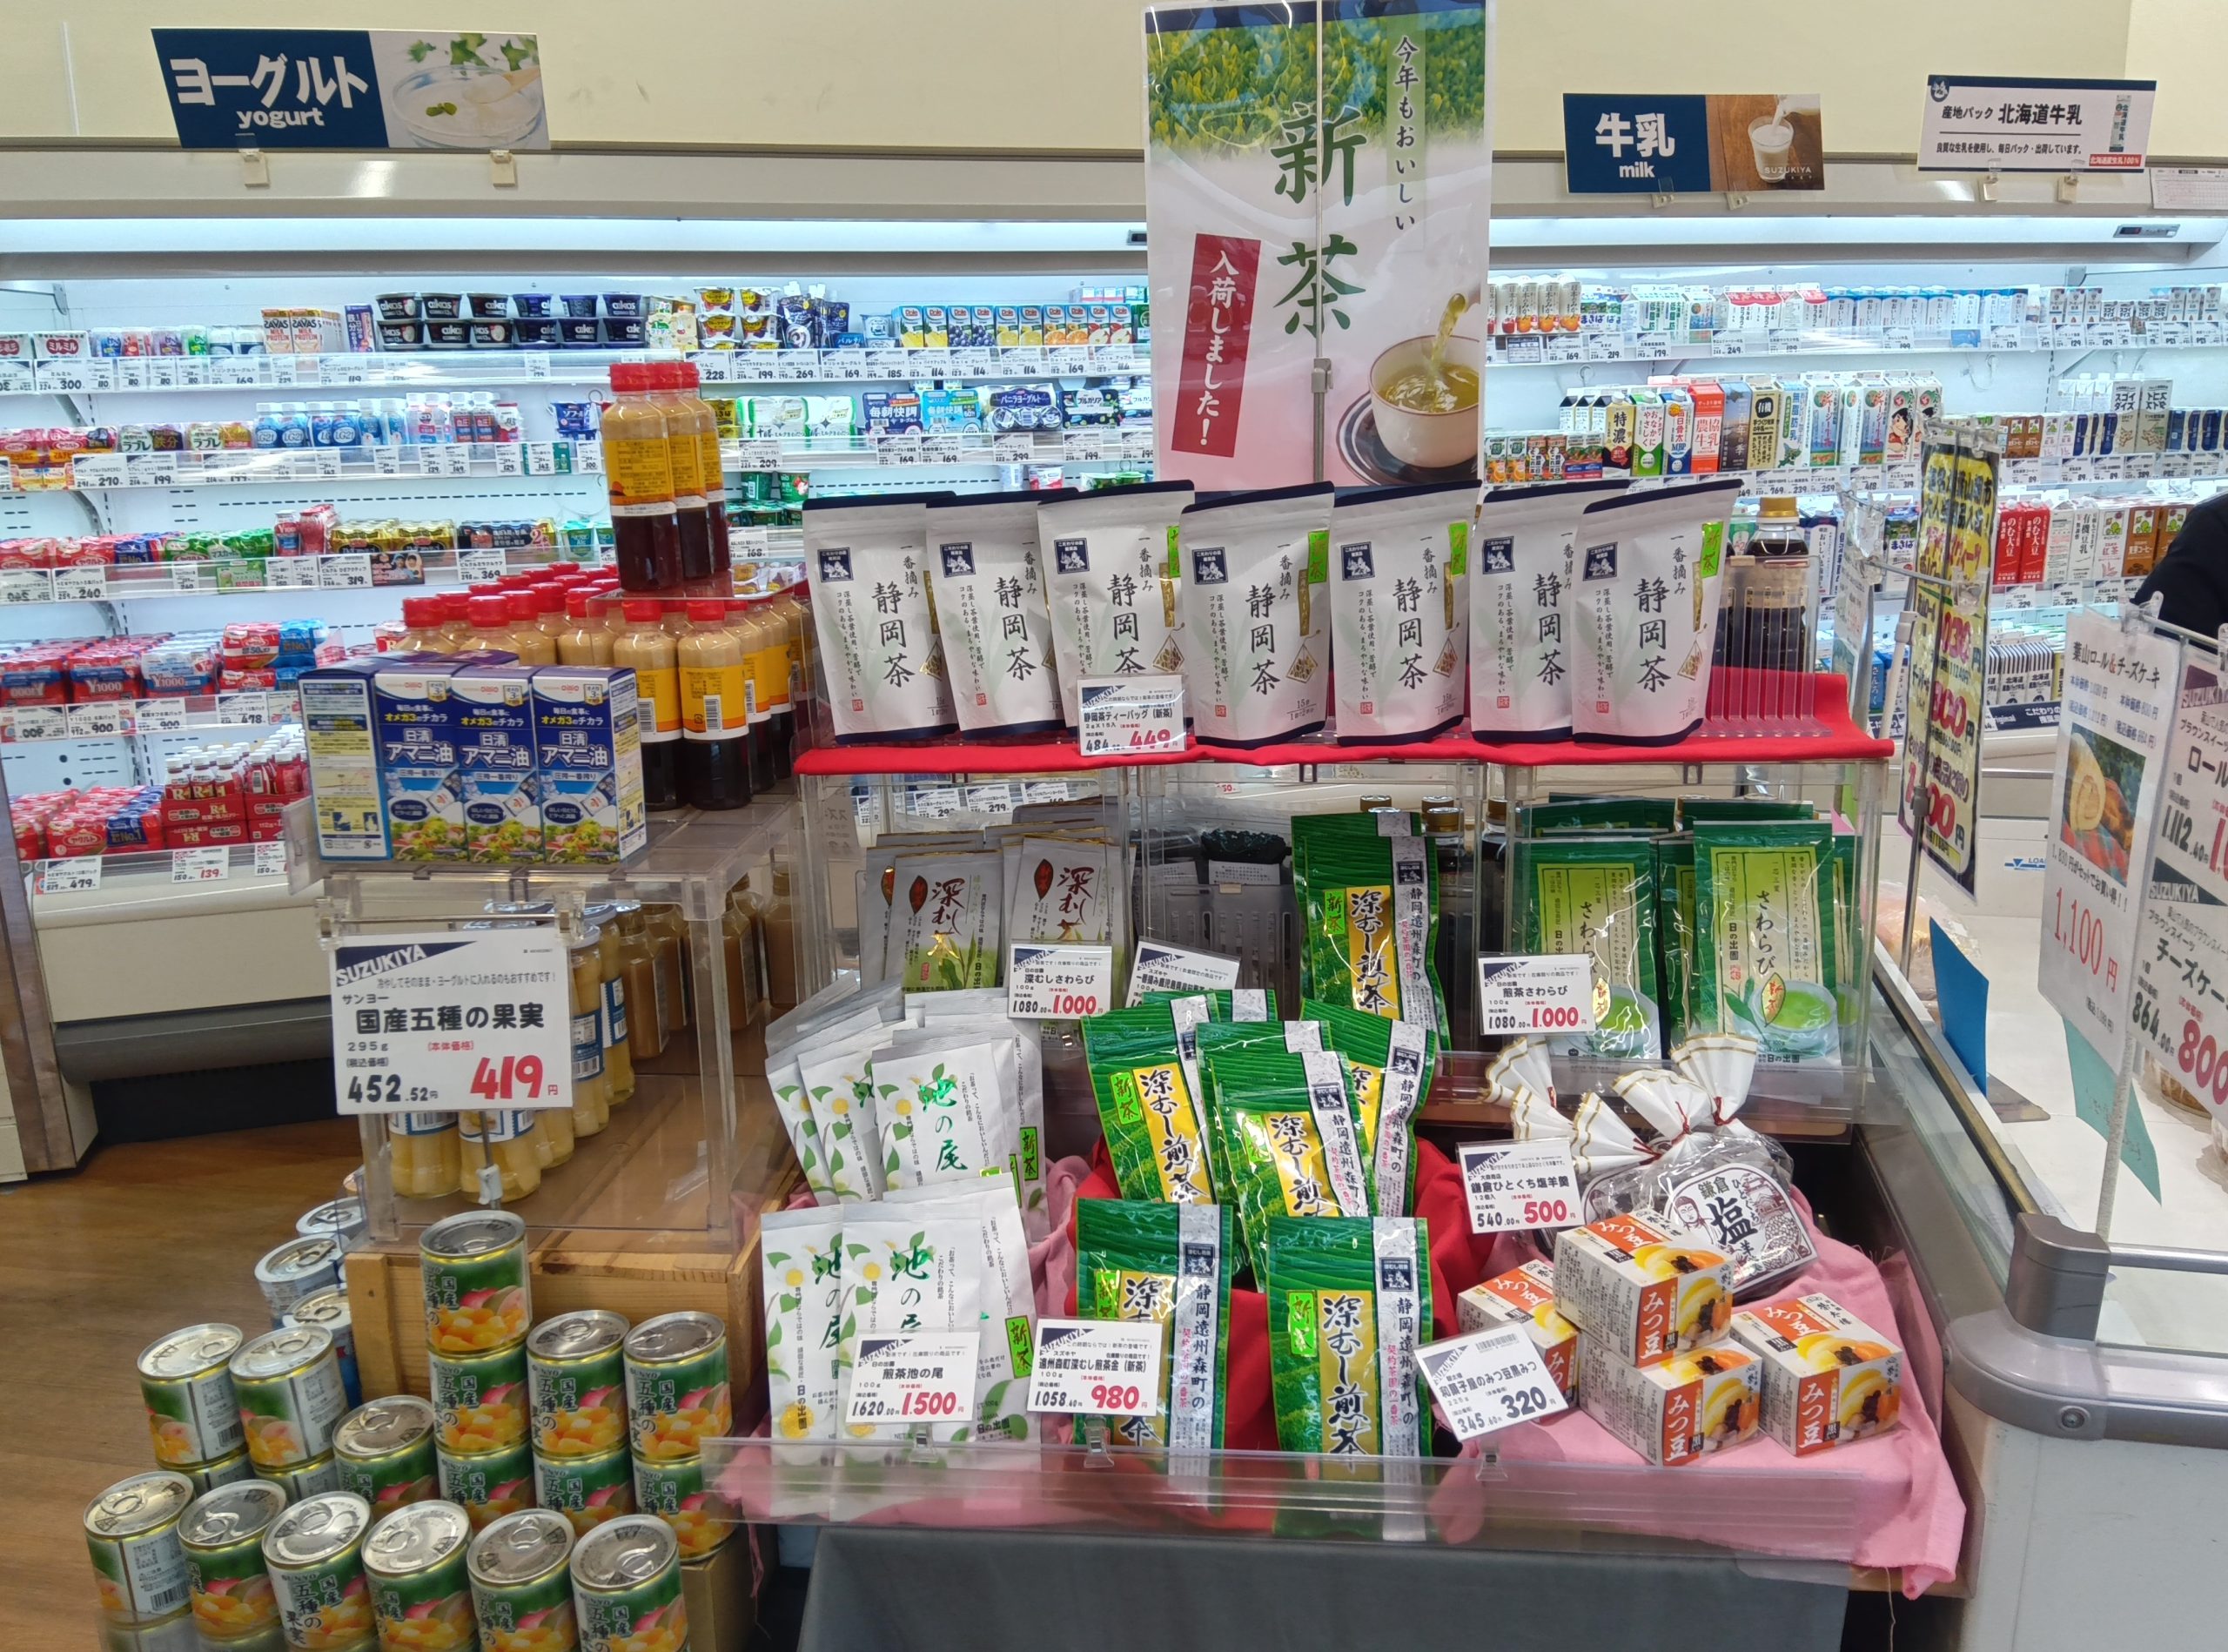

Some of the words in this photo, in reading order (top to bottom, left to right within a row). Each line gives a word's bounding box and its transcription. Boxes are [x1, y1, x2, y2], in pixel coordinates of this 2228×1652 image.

[170, 52, 369, 110] ヨーグルト
[236, 107, 325, 130] yogurt
[1998, 103, 2083, 125] 北海道牛乳
[1393, 35, 1421, 232] 今年もおいしい
[1594, 111, 1675, 159] 牛乳
[1619, 162, 1655, 179] milk
[1764, 165, 1812, 174] SUZUKIYA
[1270, 100, 1367, 336] 新茶
[60, 379, 82, 390] 300
[706, 371, 724, 380] 228
[758, 371, 774, 379] 199
[796, 370, 814, 379] 269
[844, 369, 860, 379] 169
[888, 369, 903, 378] 185
[869, 406, 918, 418] 毎朝快調
[1001, 394, 1043, 405] バニラヨーグルト
[1613, 411, 1628, 445] 特濃
[79, 588, 101, 599] 240
[871, 580, 916, 688] 静岡茶
[993, 574, 1038, 682] 静岡茶
[1106, 572, 1147, 675] 静岡茶
[1245, 582, 1281, 696] 静岡茶
[1392, 575, 1429, 690] 静岡茶
[1532, 571, 1567, 687] 静岡茶
[1633, 575, 1672, 694] 静岡茶
[88, 679, 122, 694] Y1000
[151, 675, 185, 688] Y1000
[91, 722, 113, 734] 900
[403, 728, 432, 744] 日清
[480, 731, 509, 748] 日清
[560, 730, 587, 747] 日清
[385, 742, 455, 764] アマニ油
[461, 746, 531, 768] アマニ油
[541, 744, 608, 768] アマニ油
[70, 877, 92, 890] 479
[200, 869, 219, 878] 139
[2148, 881, 2200, 903] SUZUKIYA
[1327, 892, 1344, 932] 新茶
[1409, 887, 1424, 982] 静岡遠州森町の
[1728, 922, 1739, 961] 日の出園
[1755, 890, 1775, 976] さわらび
[336, 944, 427, 987] SUZUKIYA
[1350, 889, 1394, 1016] 深むし煎茶
[1024, 974, 1095, 984] 深むしさわらび
[1503, 985, 1567, 998] 煎茶さわらび
[342, 994, 389, 1004] サンヨー
[355, 1002, 545, 1035] 国産五種の果実
[1115, 1076, 1137, 1121] 新茶
[1022, 1132, 1038, 1179] 新茶
[1698, 1176, 1730, 1199] 鎌倉
[1640, 1291, 1665, 1360] みつ豆
[1010, 1320, 1032, 1373] 新茶
[1191, 1284, 1212, 1409] 静岡遠州森町の
[1396, 1297, 1414, 1425] 静岡遠州森町の
[882, 1367, 943, 1380] 煎茶池の尾
[1322, 1293, 1372, 1473] 深むし煎茶
[560, 1379, 578, 1411] 国産
[658, 1380, 676, 1414] 国産
[1665, 1393, 1690, 1463] みつ豆
[1798, 1382, 1826, 1449] みつ豆
[319, 1575, 343, 1607] 国産
